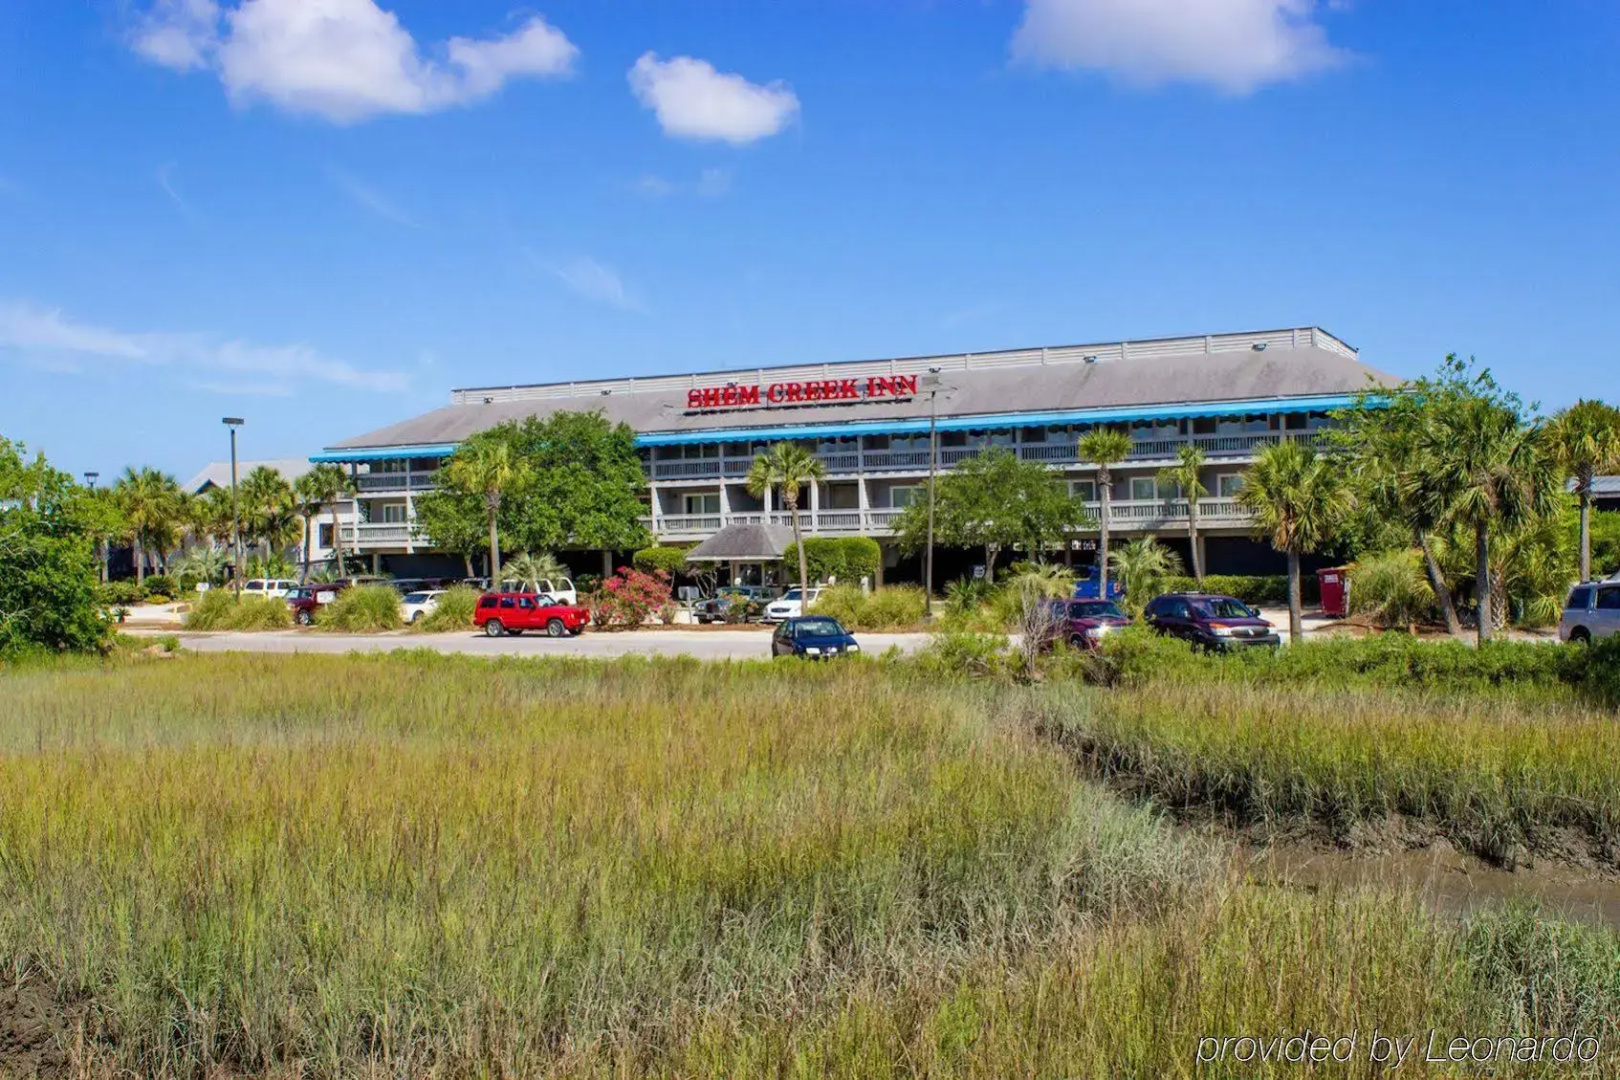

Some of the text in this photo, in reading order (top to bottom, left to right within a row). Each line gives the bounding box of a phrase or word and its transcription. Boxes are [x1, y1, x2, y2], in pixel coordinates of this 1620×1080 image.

[687, 375, 918, 408] SHEM CREEK INN
